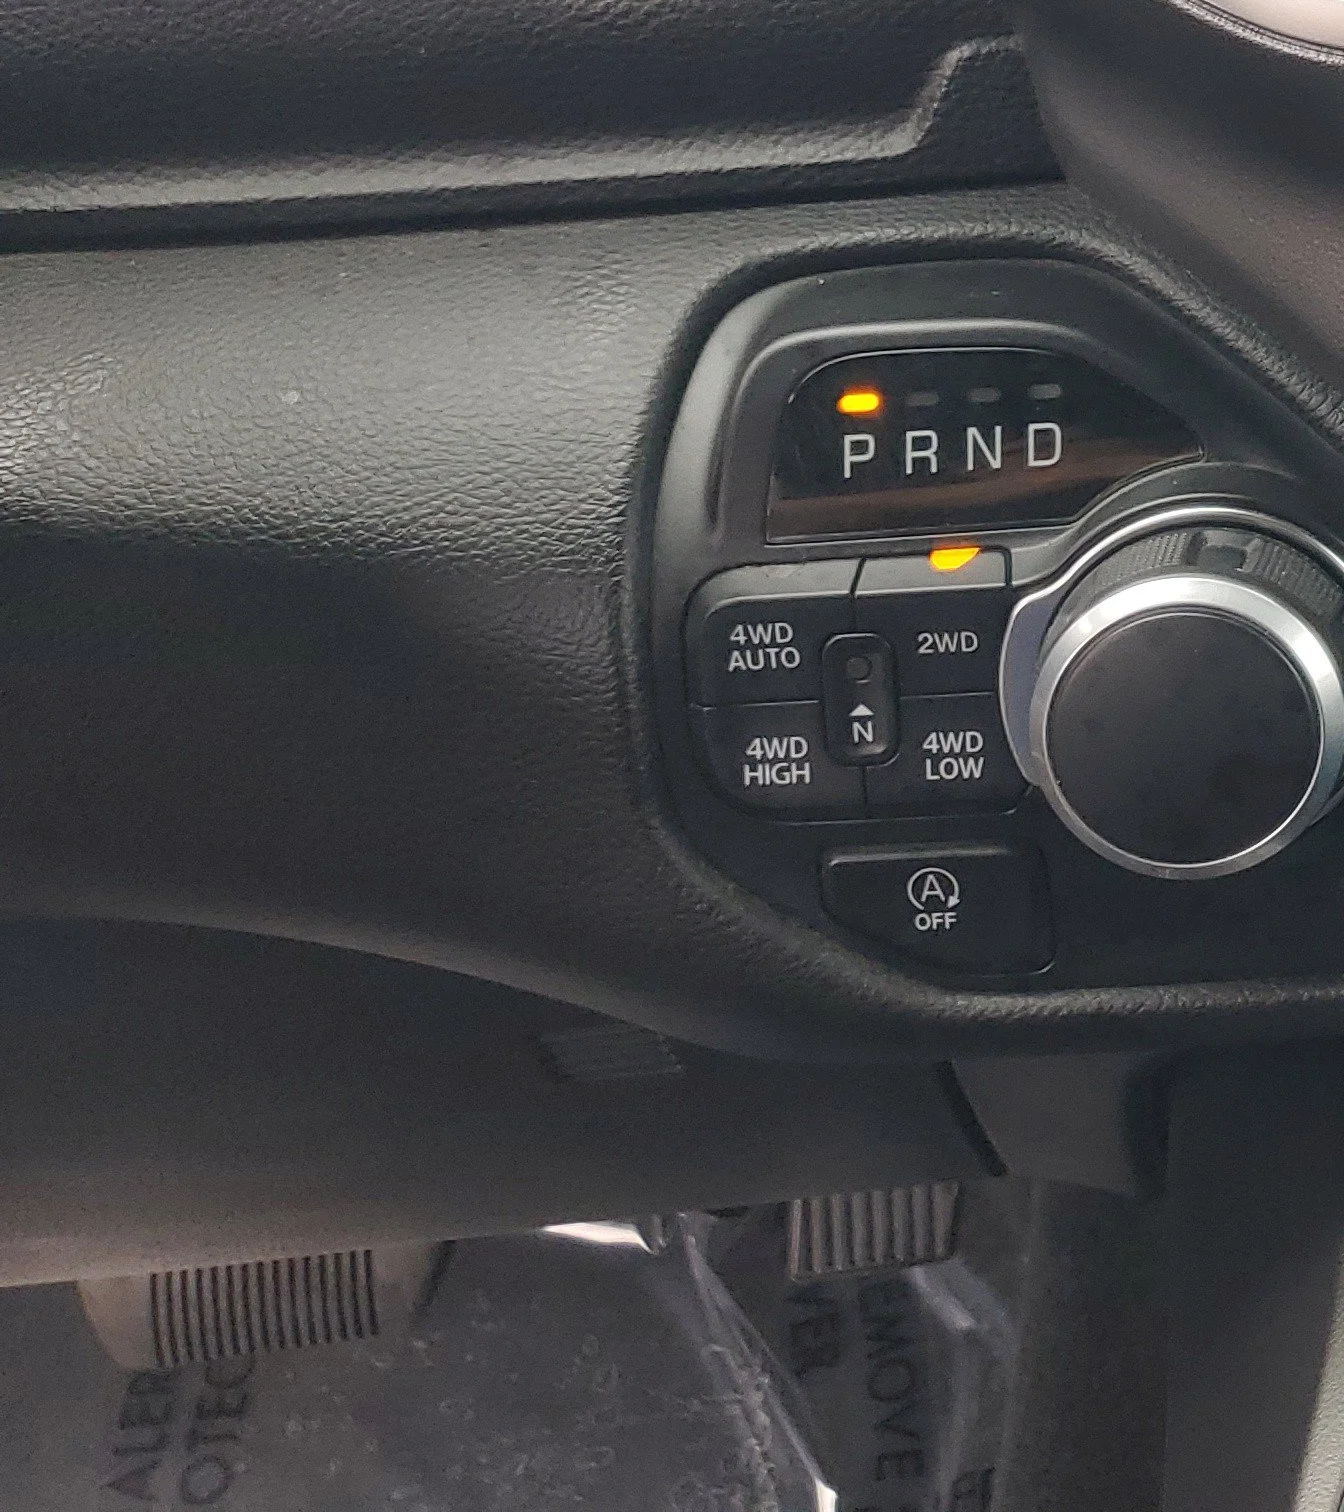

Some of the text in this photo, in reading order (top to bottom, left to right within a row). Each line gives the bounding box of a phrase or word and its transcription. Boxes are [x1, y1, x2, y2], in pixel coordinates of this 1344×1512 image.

[842, 421, 1063, 479] P R N D
[729, 622, 794, 647] 4WD
[916, 631, 979, 655] 2WD
[727, 646, 801, 671] AUTO
[852, 721, 875, 744] N
[921, 730, 984, 755] 4WD
[744, 736, 809, 761] 4WD
[742, 761, 812, 787] HIGH
[924, 755, 984, 781] LOW
[913, 911, 958, 931] OFF
